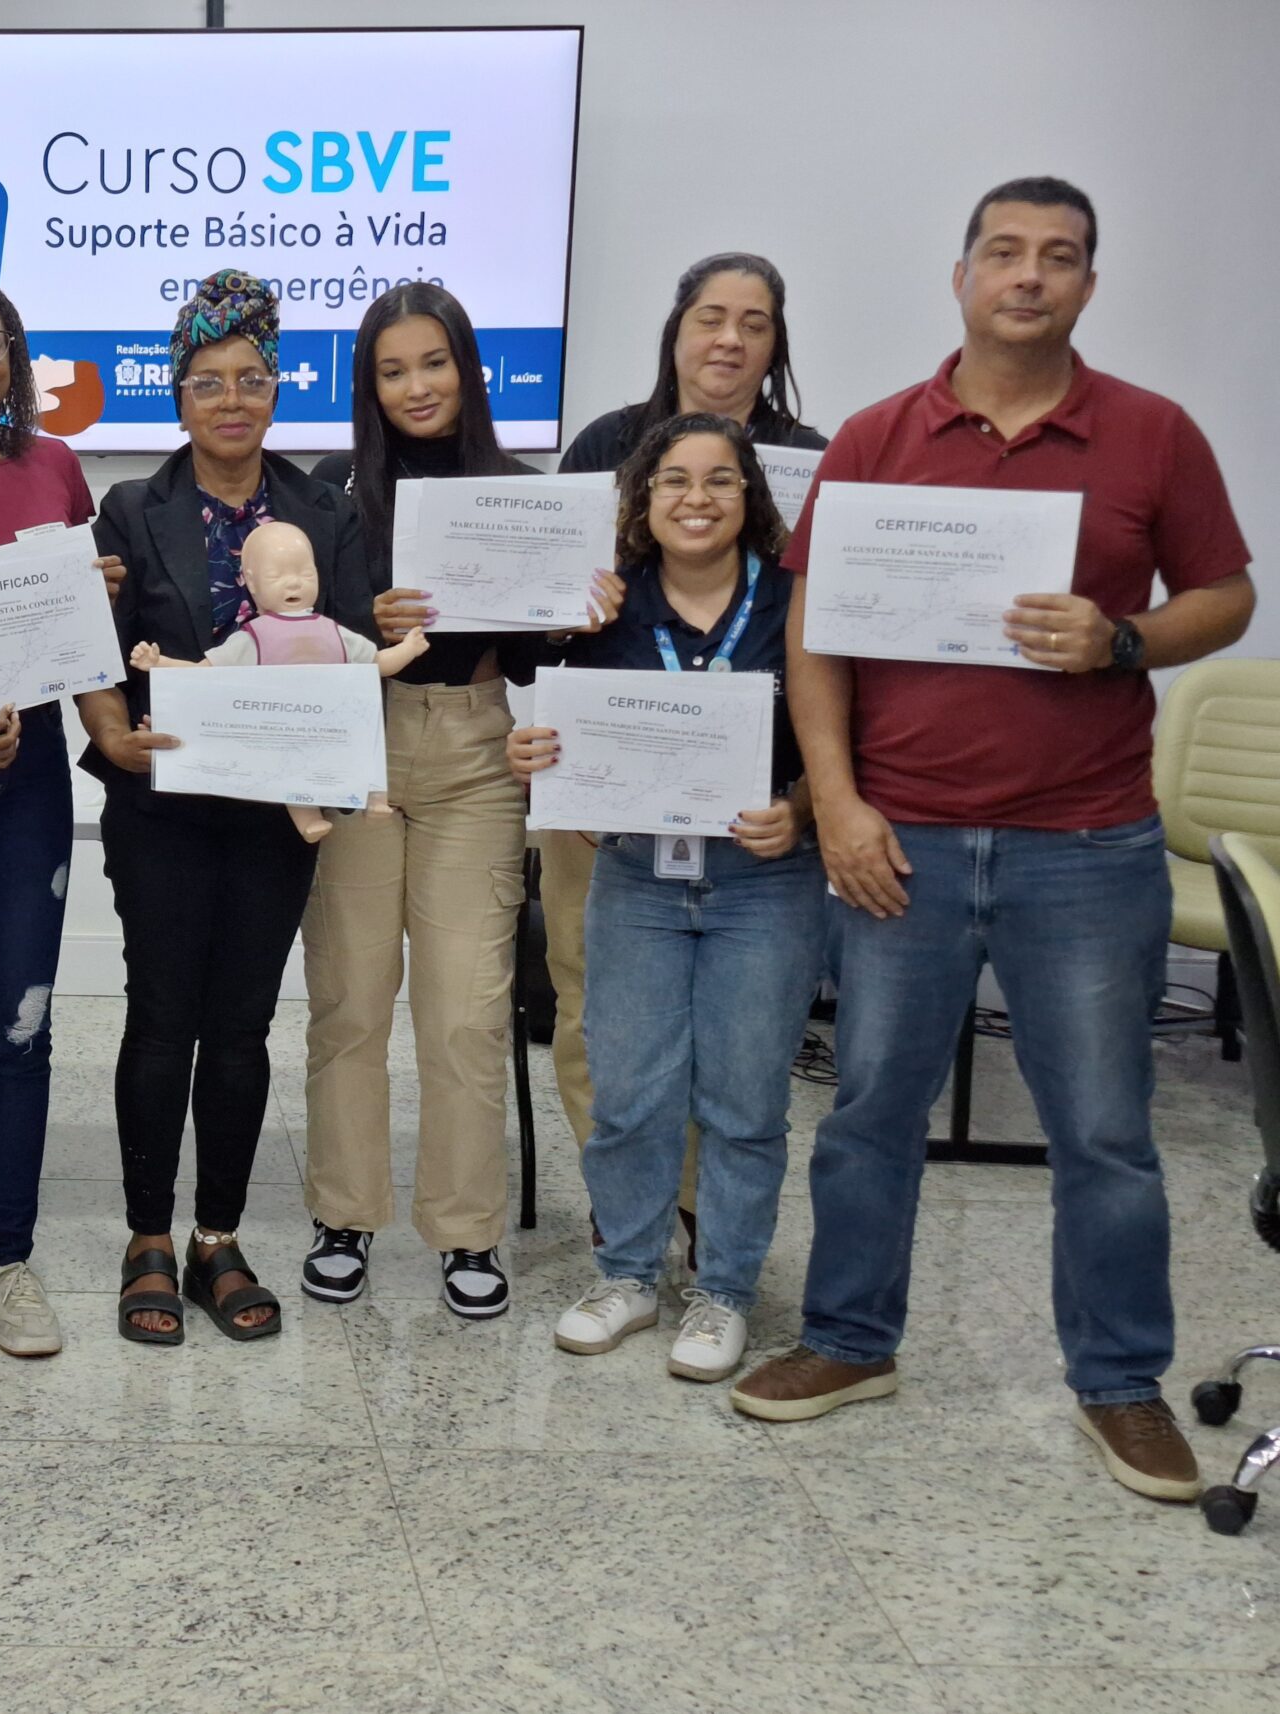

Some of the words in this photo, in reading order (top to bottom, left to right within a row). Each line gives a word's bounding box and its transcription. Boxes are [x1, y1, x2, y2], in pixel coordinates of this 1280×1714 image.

[42, 131, 246, 195] Curso
[262, 130, 451, 193] SBVE
[45, 217, 189, 256] Suporte
[204, 211, 321, 248] Básico
[335, 211, 354, 248] à
[367, 211, 448, 247] Vida
[116, 343, 169, 356] Realização:
[144, 364, 172, 386] Ri
[510, 371, 543, 383] SAÚDE
[116, 388, 171, 396] PREFEITU
[762, 464, 815, 478] TIFICAD
[475, 496, 563, 512] CERTIFICADO
[510, 524, 537, 533] SILVA
[875, 519, 977, 535] CERTIFICADO
[16, 603, 28, 612] DA
[536, 608, 554, 618] RIO
[947, 642, 968, 653] RIO
[48, 682, 66, 694] RIO
[232, 699, 323, 714] CERTIFICADO
[608, 696, 702, 716] CERTIFICADO
[672, 814, 691, 825] RIO
